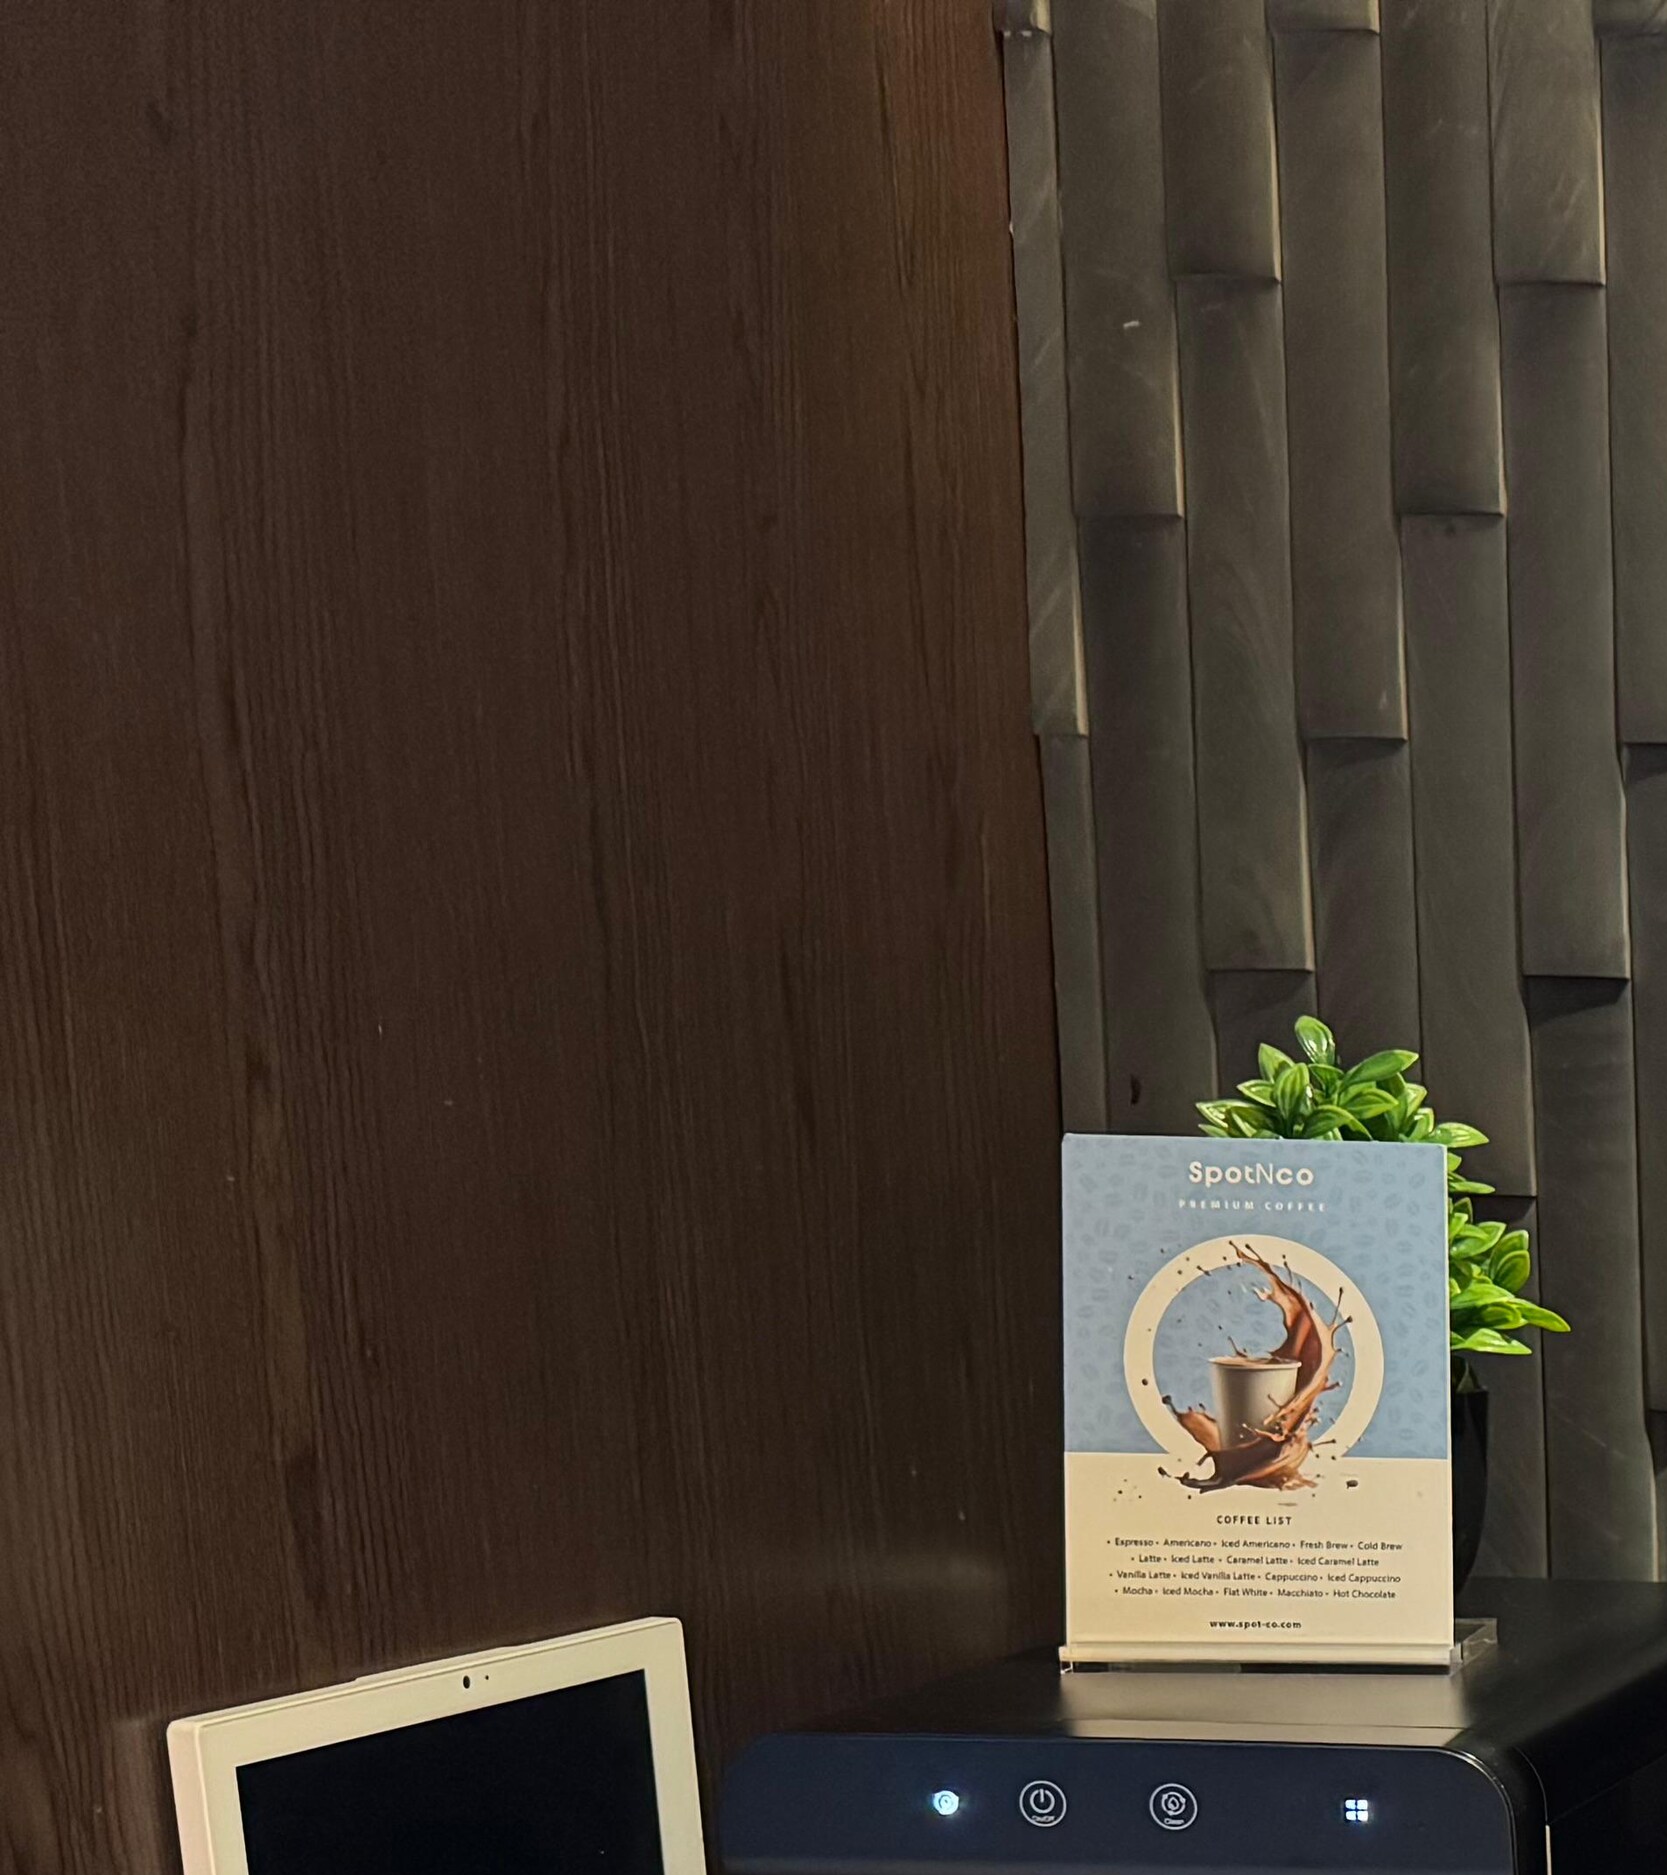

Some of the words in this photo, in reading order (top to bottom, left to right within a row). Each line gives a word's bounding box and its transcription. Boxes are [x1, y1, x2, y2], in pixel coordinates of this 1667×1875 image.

[1189, 1161, 1314, 1188] SpotNco
[1179, 1200, 1254, 1209] PREMIUM
[1265, 1202, 1325, 1212] COFFEE
[1217, 1515, 1260, 1524] COFFEE
[1266, 1516, 1292, 1525] LIST
[1115, 1538, 1153, 1547] Espresso
[1163, 1539, 1211, 1547] Americano
[1242, 1540, 1290, 1548] Americano
[1300, 1540, 1324, 1549] Fresh
[1326, 1541, 1348, 1549] Brew
[1358, 1542, 1378, 1550] Cold
[1139, 1555, 1161, 1563] Latte
[1171, 1555, 1189, 1563] Iced
[1192, 1555, 1214, 1563] Latte
[1227, 1556, 1263, 1564] Caramel
[1266, 1557, 1288, 1565] Latte
[1297, 1557, 1316, 1565] Iced
[1318, 1557, 1354, 1566] Caramel
[1357, 1558, 1379, 1566] Latte
[1117, 1570, 1146, 1579] Vanilla
[1149, 1571, 1171, 1579] Latte
[1181, 1571, 1199, 1579] Iced
[1202, 1572, 1230, 1580] Vanilla
[1233, 1572, 1255, 1580] Latte
[1265, 1573, 1318, 1581] Cappuccino
[1328, 1573, 1346, 1581] Iced
[1348, 1574, 1401, 1583] Cappuccino
[1122, 1586, 1153, 1595] Mocha
[1163, 1587, 1181, 1595] Iced
[1184, 1587, 1213, 1595] Mocha
[1223, 1588, 1240, 1596] Flat
[1242, 1588, 1267, 1596] White
[1277, 1589, 1323, 1597] Macchiato
[1333, 1590, 1349, 1598] Hot
[1352, 1590, 1396, 1598] Chocolate
[1210, 1621, 1301, 1629] www.spot-co.com
